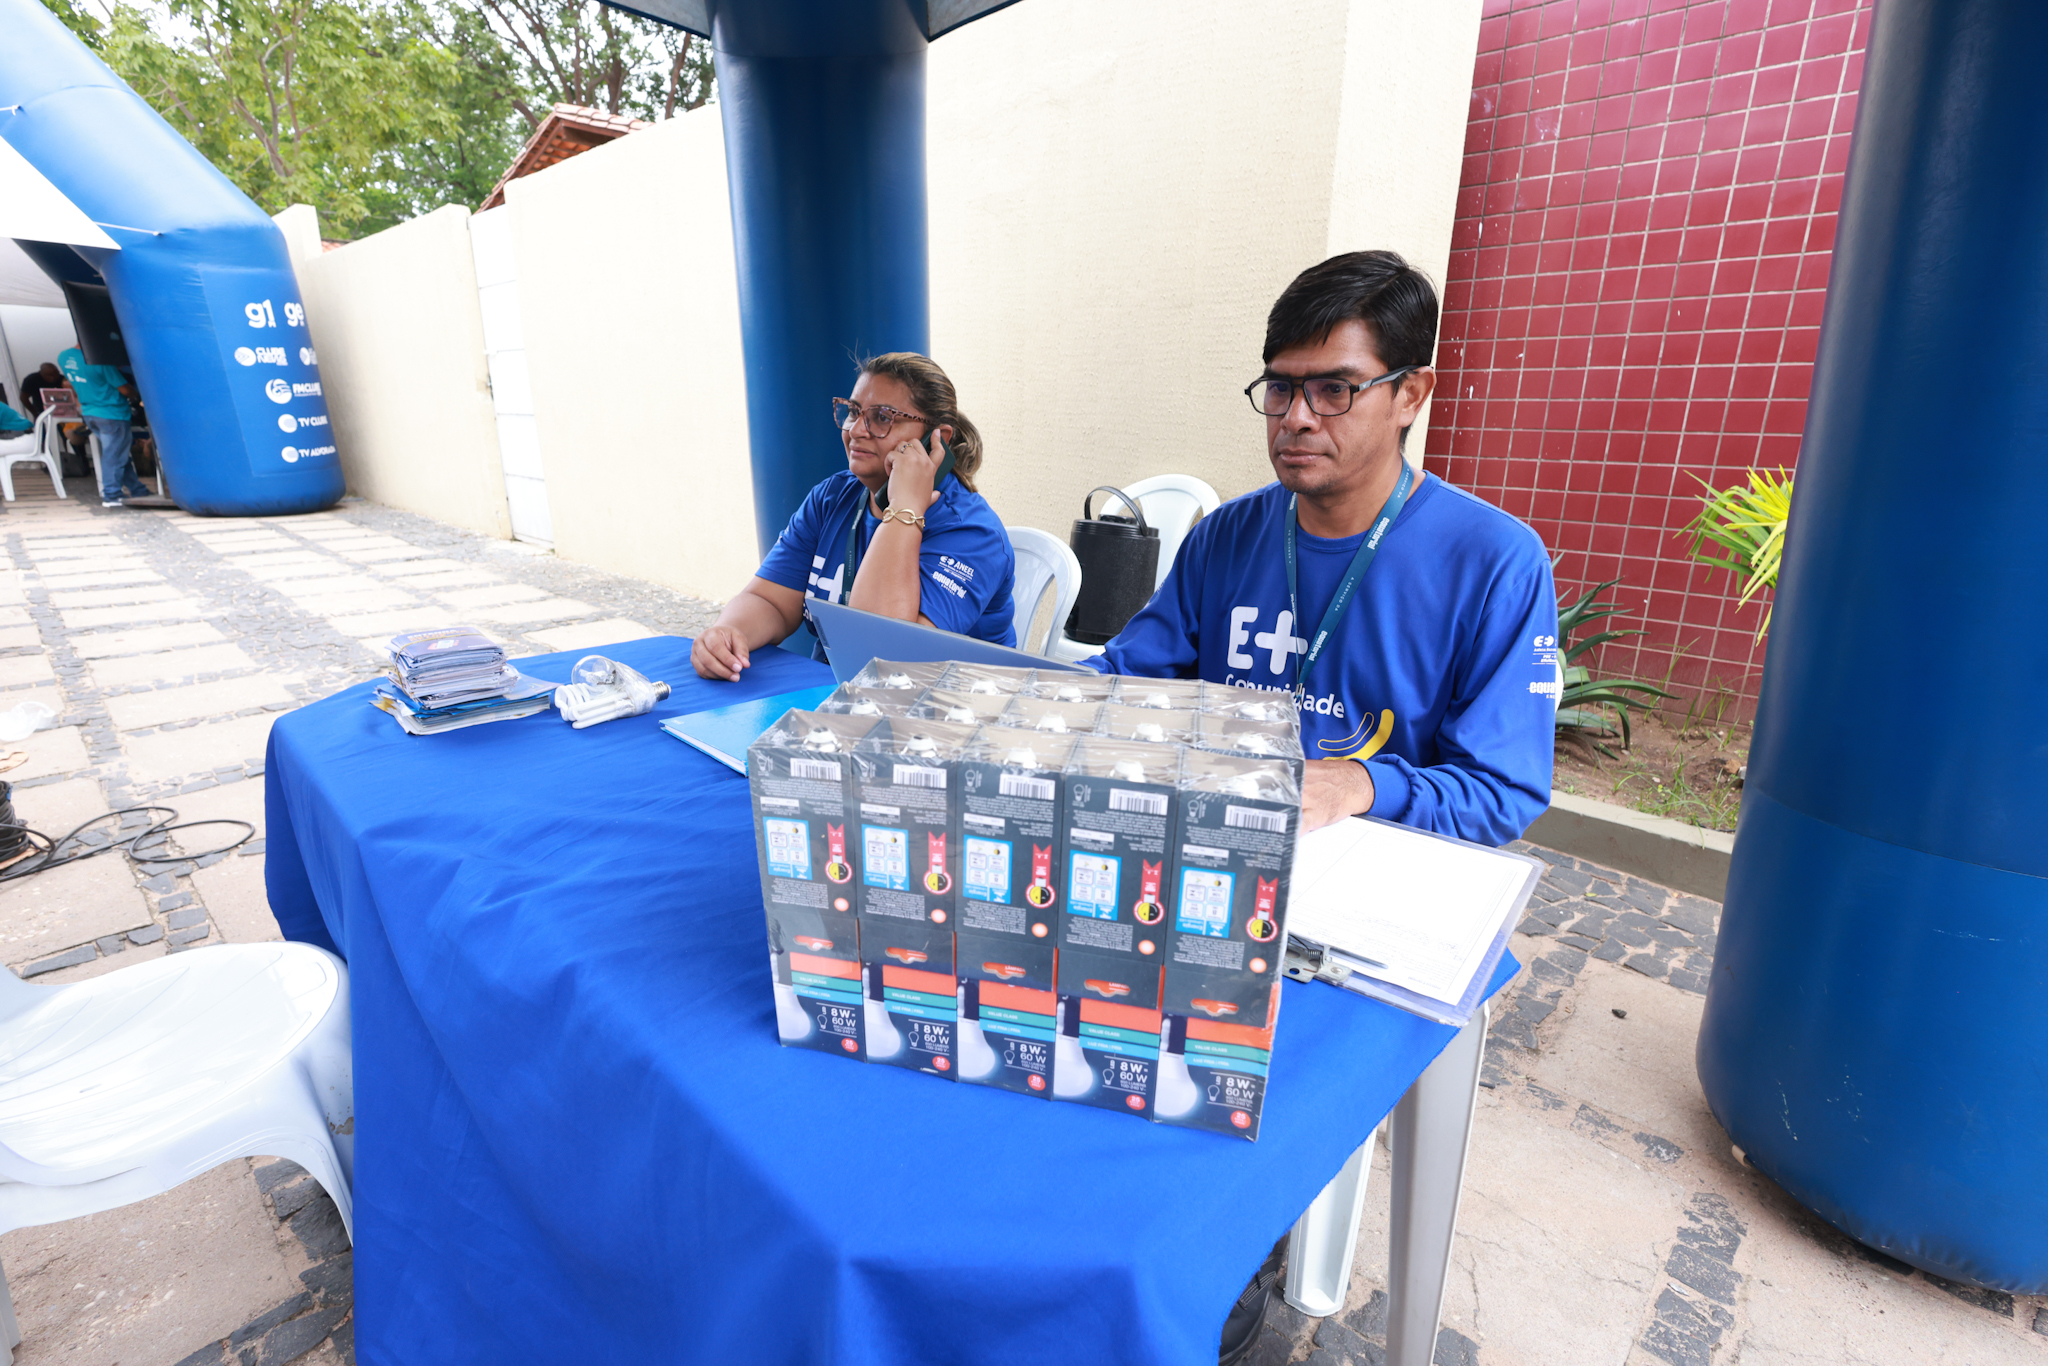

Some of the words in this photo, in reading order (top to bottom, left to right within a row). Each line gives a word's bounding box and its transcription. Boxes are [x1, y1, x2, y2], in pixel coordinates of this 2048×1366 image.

[298, 417, 310, 427] TV
[298, 448, 310, 458] TV
[1367, 516, 1390, 550] equatorial
[954, 561, 975, 577] ANEEL
[932, 571, 967, 599] equatorial
[1308, 630, 1328, 661] equatorial
[831, 1008, 839, 1017] 8
[839, 1009, 851, 1019] W
[831, 1016, 844, 1026] 60
[845, 1018, 856, 1027] W
[923, 1024, 931, 1034] 8
[932, 1025, 944, 1035] W
[924, 1033, 936, 1043] 60
[938, 1035, 949, 1045] W
[1020, 1043, 1027, 1053] 8
[1028, 1044, 1041, 1055] W
[1020, 1052, 1033, 1062] 60
[1035, 1055, 1046, 1064] W
[1120, 1061, 1128, 1071] 8
[1130, 1062, 1143, 1074] W
[1120, 1071, 1133, 1081] 60
[1136, 1074, 1147, 1083] W
[1226, 1077, 1234, 1087] 8
[1236, 1078, 1250, 1090] W
[1225, 1087, 1240, 1097] 60
[1242, 1089, 1255, 1099] W
